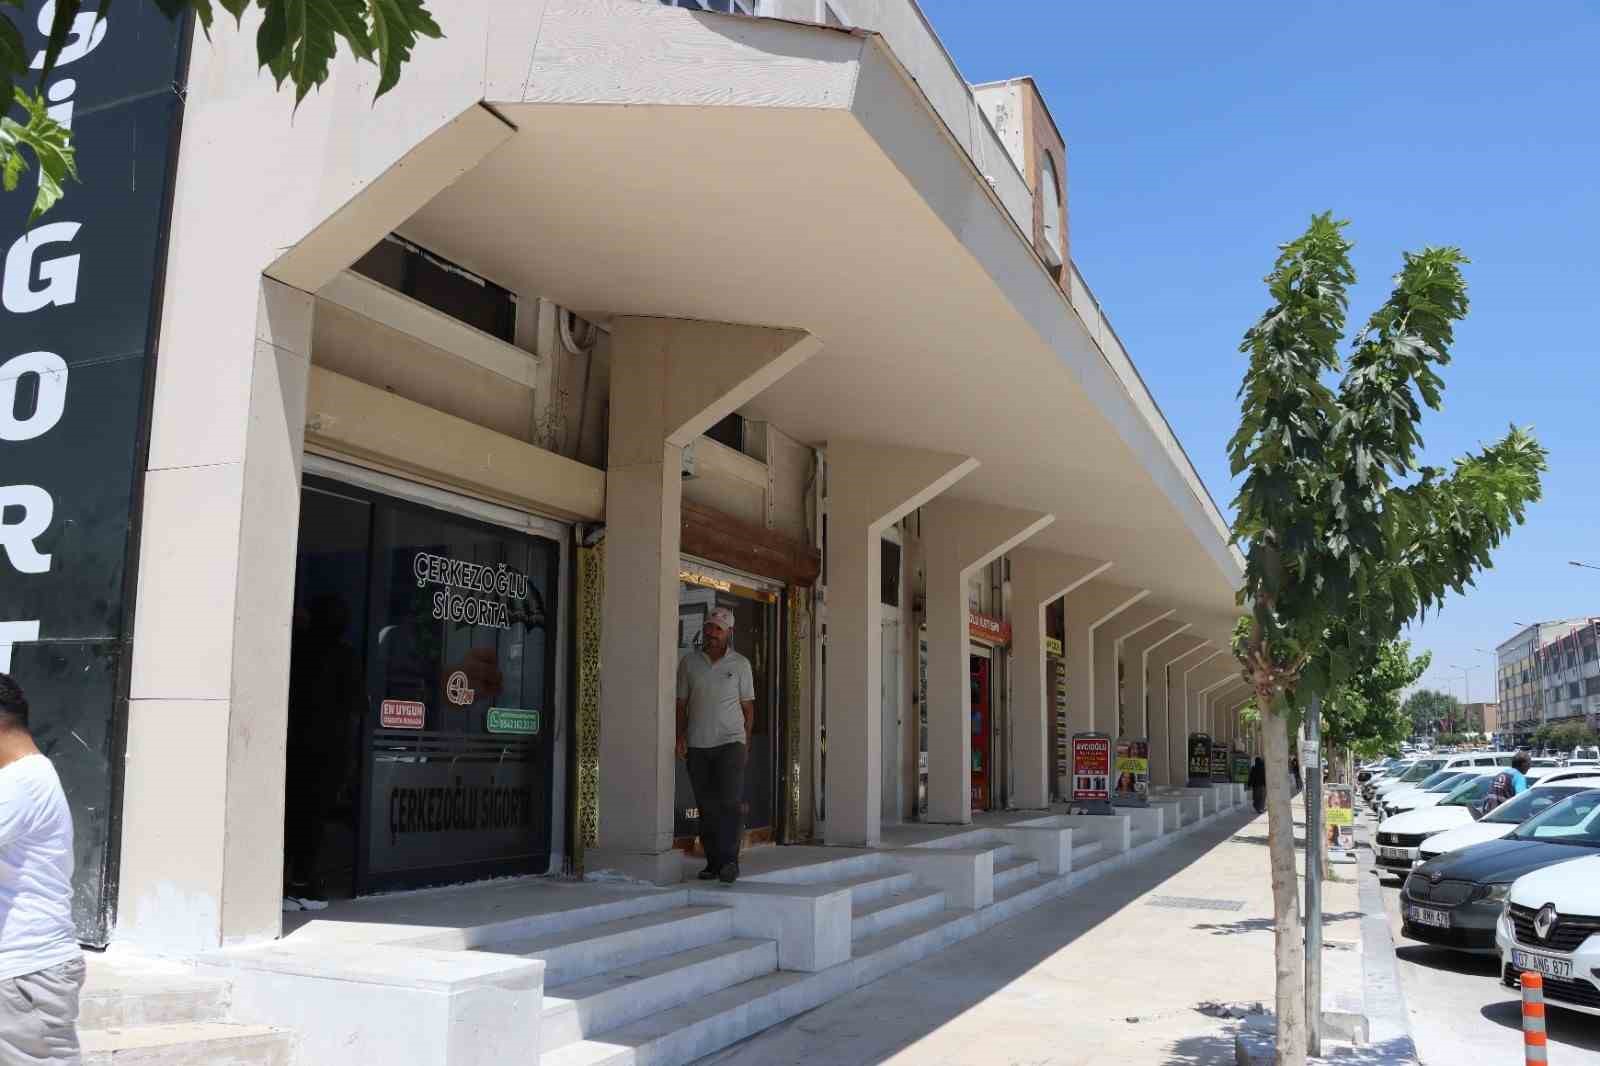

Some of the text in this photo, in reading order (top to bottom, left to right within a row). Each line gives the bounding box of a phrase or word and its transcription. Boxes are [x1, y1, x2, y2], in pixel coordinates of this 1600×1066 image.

[413, 552, 529, 600] ÇERKEZOĞLU
[432, 586, 512, 630] SİGORTA
[481, 776, 532, 829] SİGORT
[1552, 960, 1569, 976] 877
